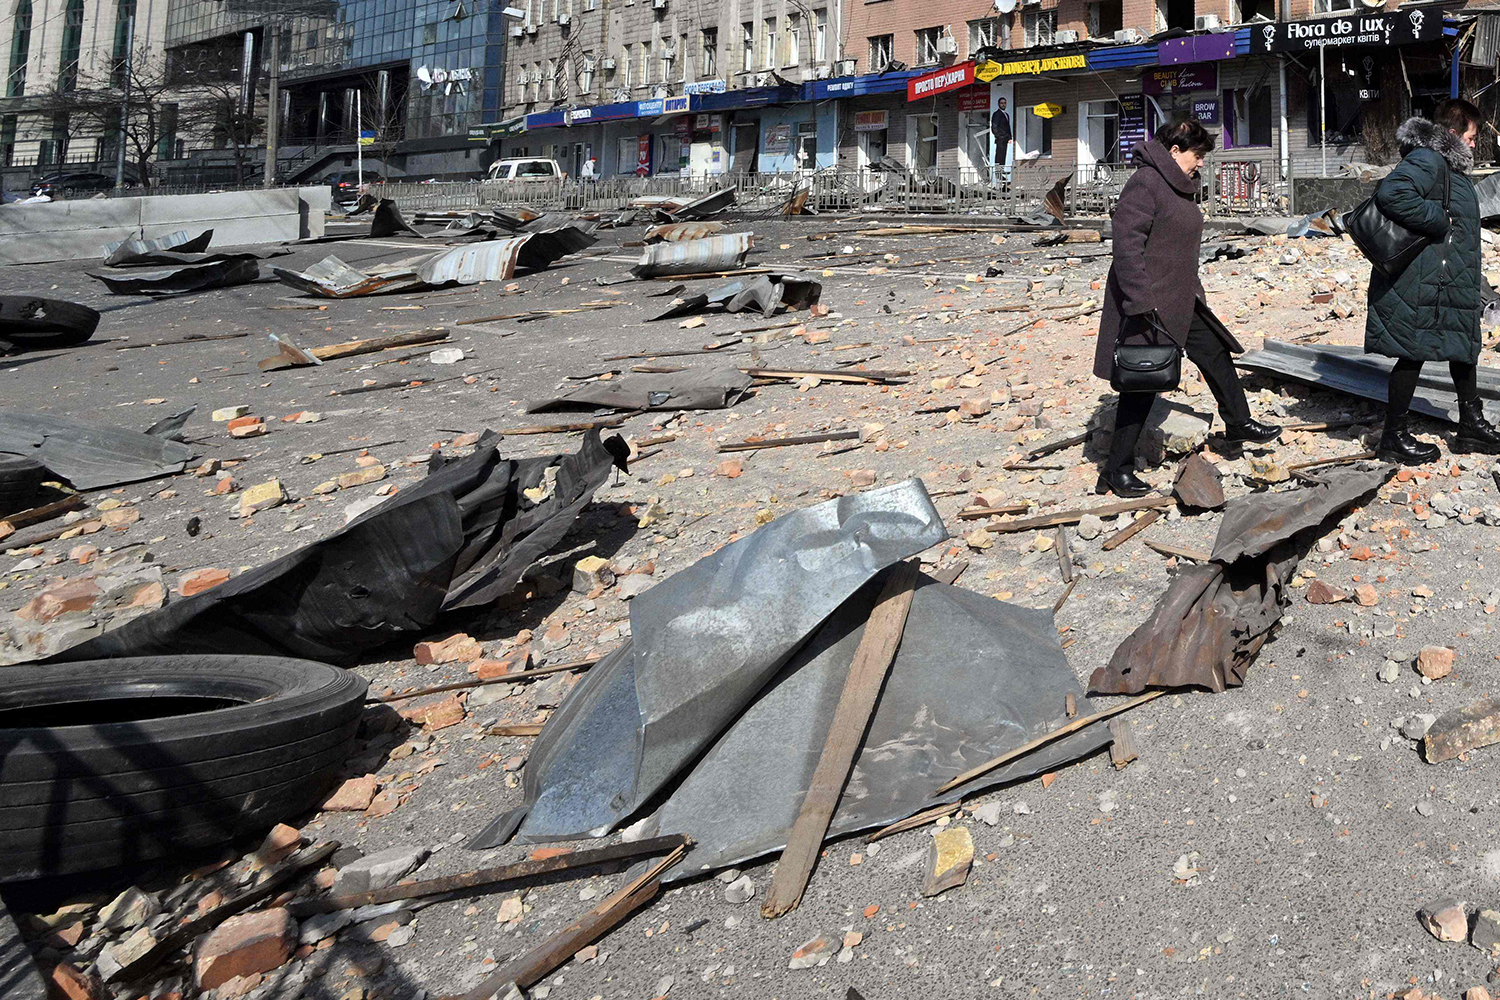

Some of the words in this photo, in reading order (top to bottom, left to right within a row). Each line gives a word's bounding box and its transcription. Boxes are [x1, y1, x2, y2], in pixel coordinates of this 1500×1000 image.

[1287, 22, 1325, 39] Flora
[1330, 18, 1352, 35] de
[1360, 17, 1384, 33] Lux
[1304, 35, 1356, 49] супермаркет
[1357, 33, 1380, 44] квітів
[1153, 71, 1177, 79] BEAUTY
[914, 79, 935, 95] ПРОСТО
[1359, 88, 1380, 99] КВІТИ
[1195, 103, 1215, 112] BROW
[1198, 112, 1212, 120] BAR
